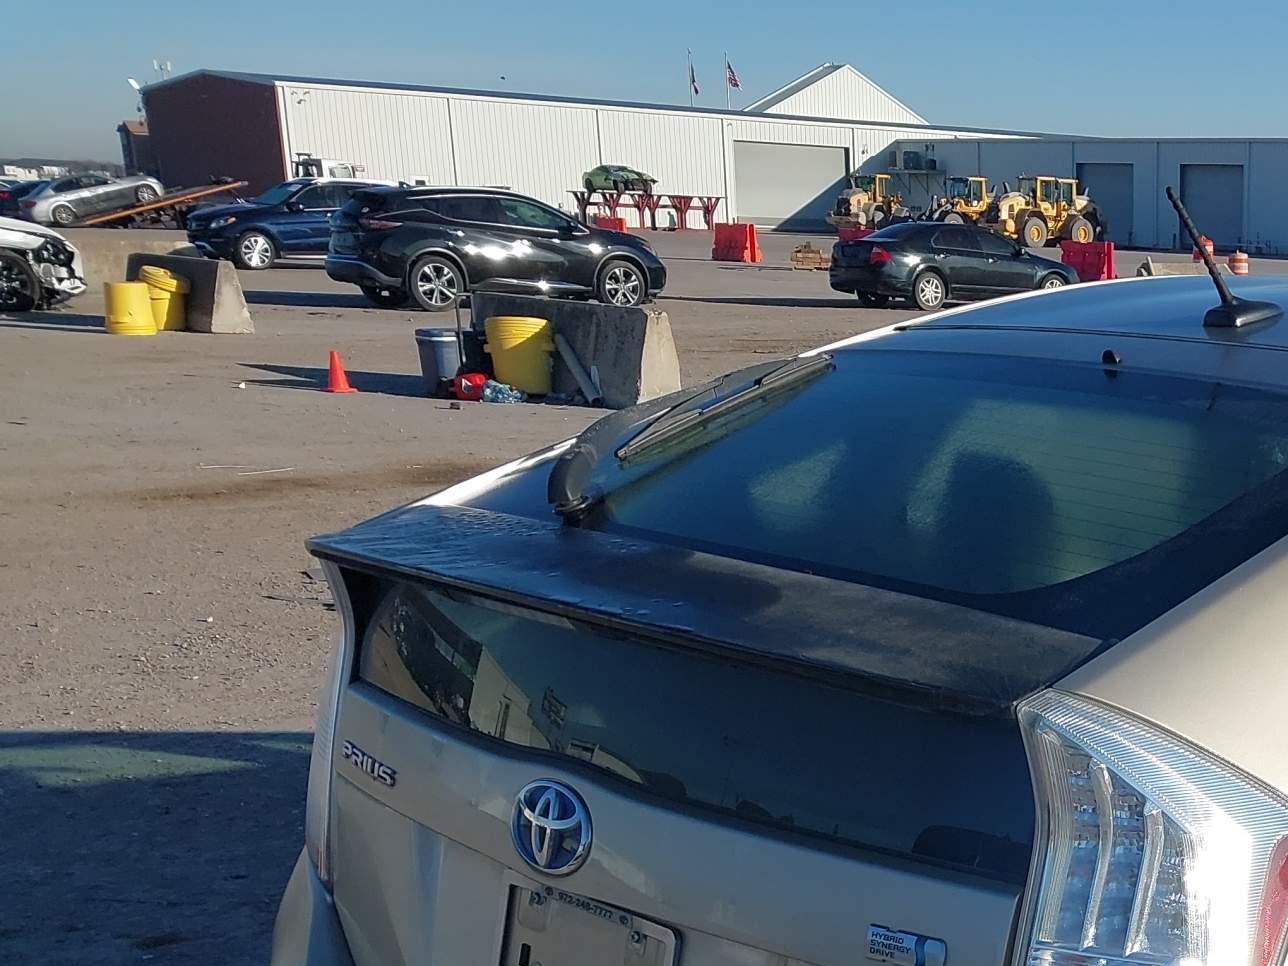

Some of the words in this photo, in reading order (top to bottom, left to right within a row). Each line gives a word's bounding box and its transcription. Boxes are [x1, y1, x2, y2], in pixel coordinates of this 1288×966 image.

[343, 740, 397, 787] PRIUS
[871, 931, 904, 945] HYBRID
[869, 947, 895, 959] DRIVE
[870, 939, 911, 954] SYNERGY
